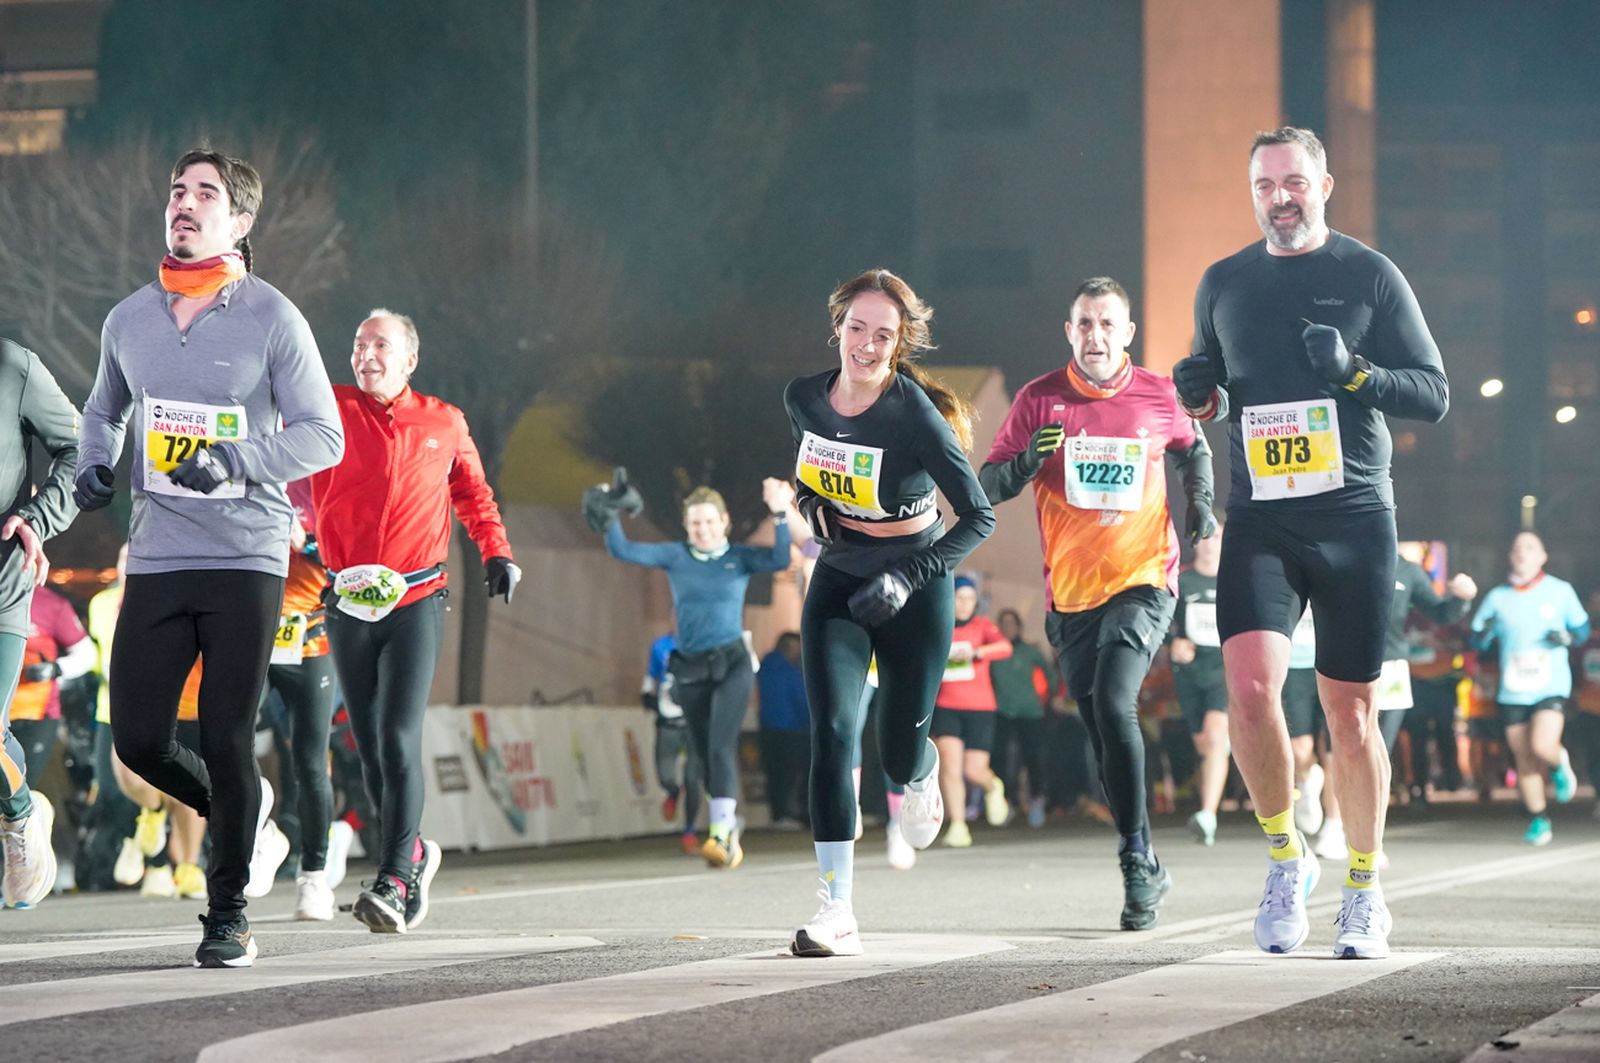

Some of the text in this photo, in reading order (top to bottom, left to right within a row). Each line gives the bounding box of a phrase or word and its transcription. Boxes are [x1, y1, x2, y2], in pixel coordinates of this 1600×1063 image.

[164, 412, 207, 425] NOCHE DE
[1257, 415, 1284, 425] NOCHE
[1287, 413, 1298, 422] DE
[153, 421, 172, 433] SAN
[1251, 427, 1265, 438] SAN
[814, 447, 838, 460] NOCHE
[836, 452, 846, 462] DE
[1084, 445, 1118, 453] NOCHE DE
[1265, 436, 1311, 466] 873
[805, 454, 820, 468] SAN
[1076, 463, 1135, 485] 12223
[819, 469, 857, 499] 874
